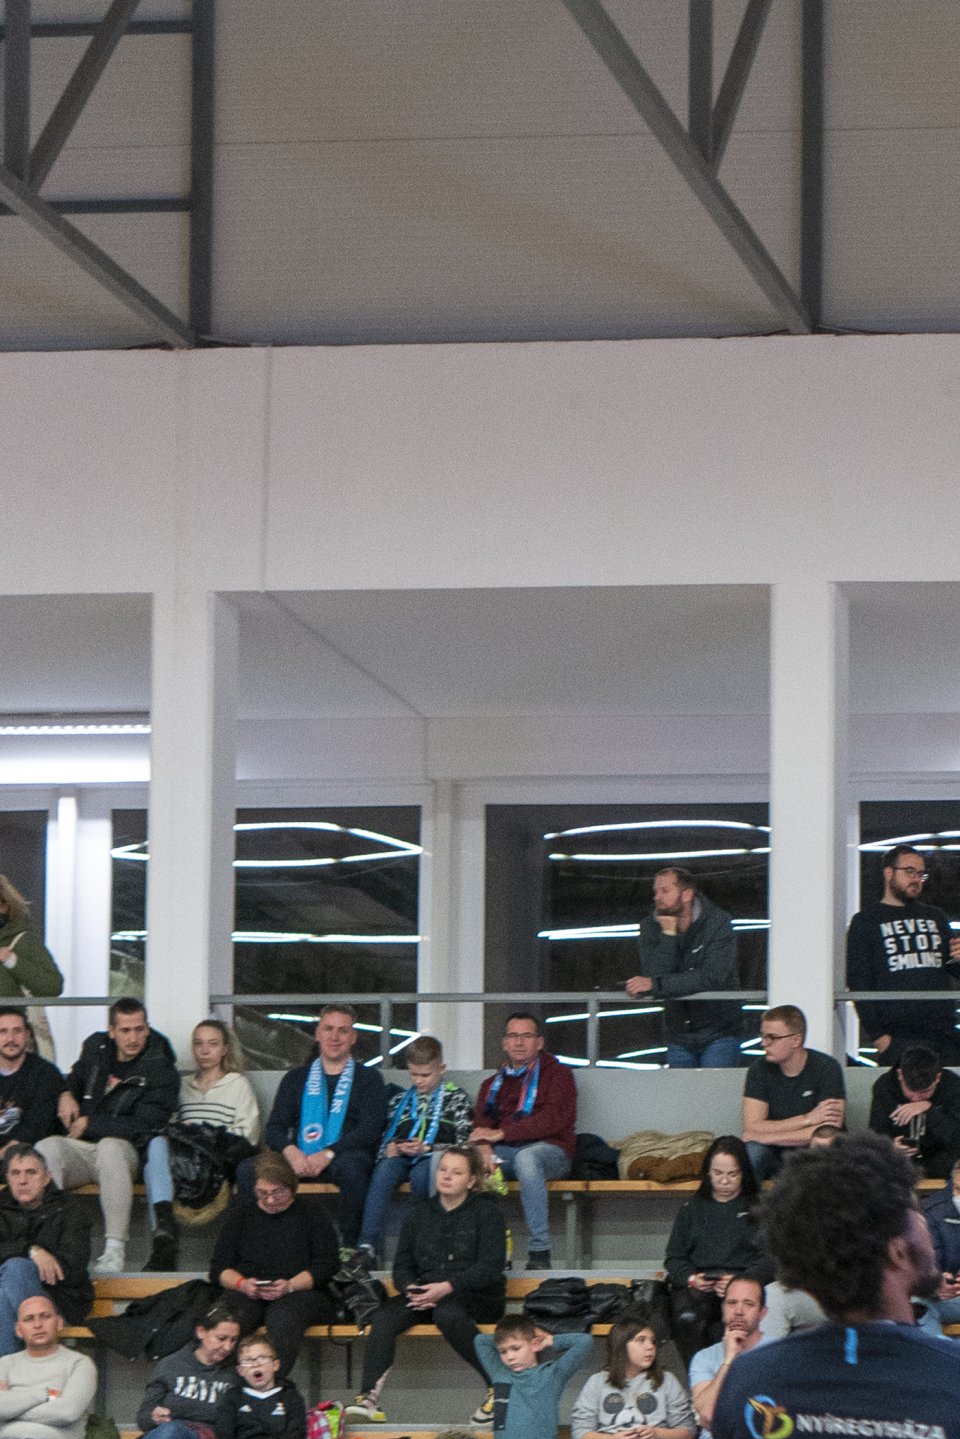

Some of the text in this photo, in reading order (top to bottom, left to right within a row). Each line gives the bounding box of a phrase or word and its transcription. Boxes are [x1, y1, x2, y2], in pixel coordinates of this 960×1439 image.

[880, 919, 939, 937] NEVER
[883, 934, 942, 954] STOP
[888, 952, 943, 972] SMILING
